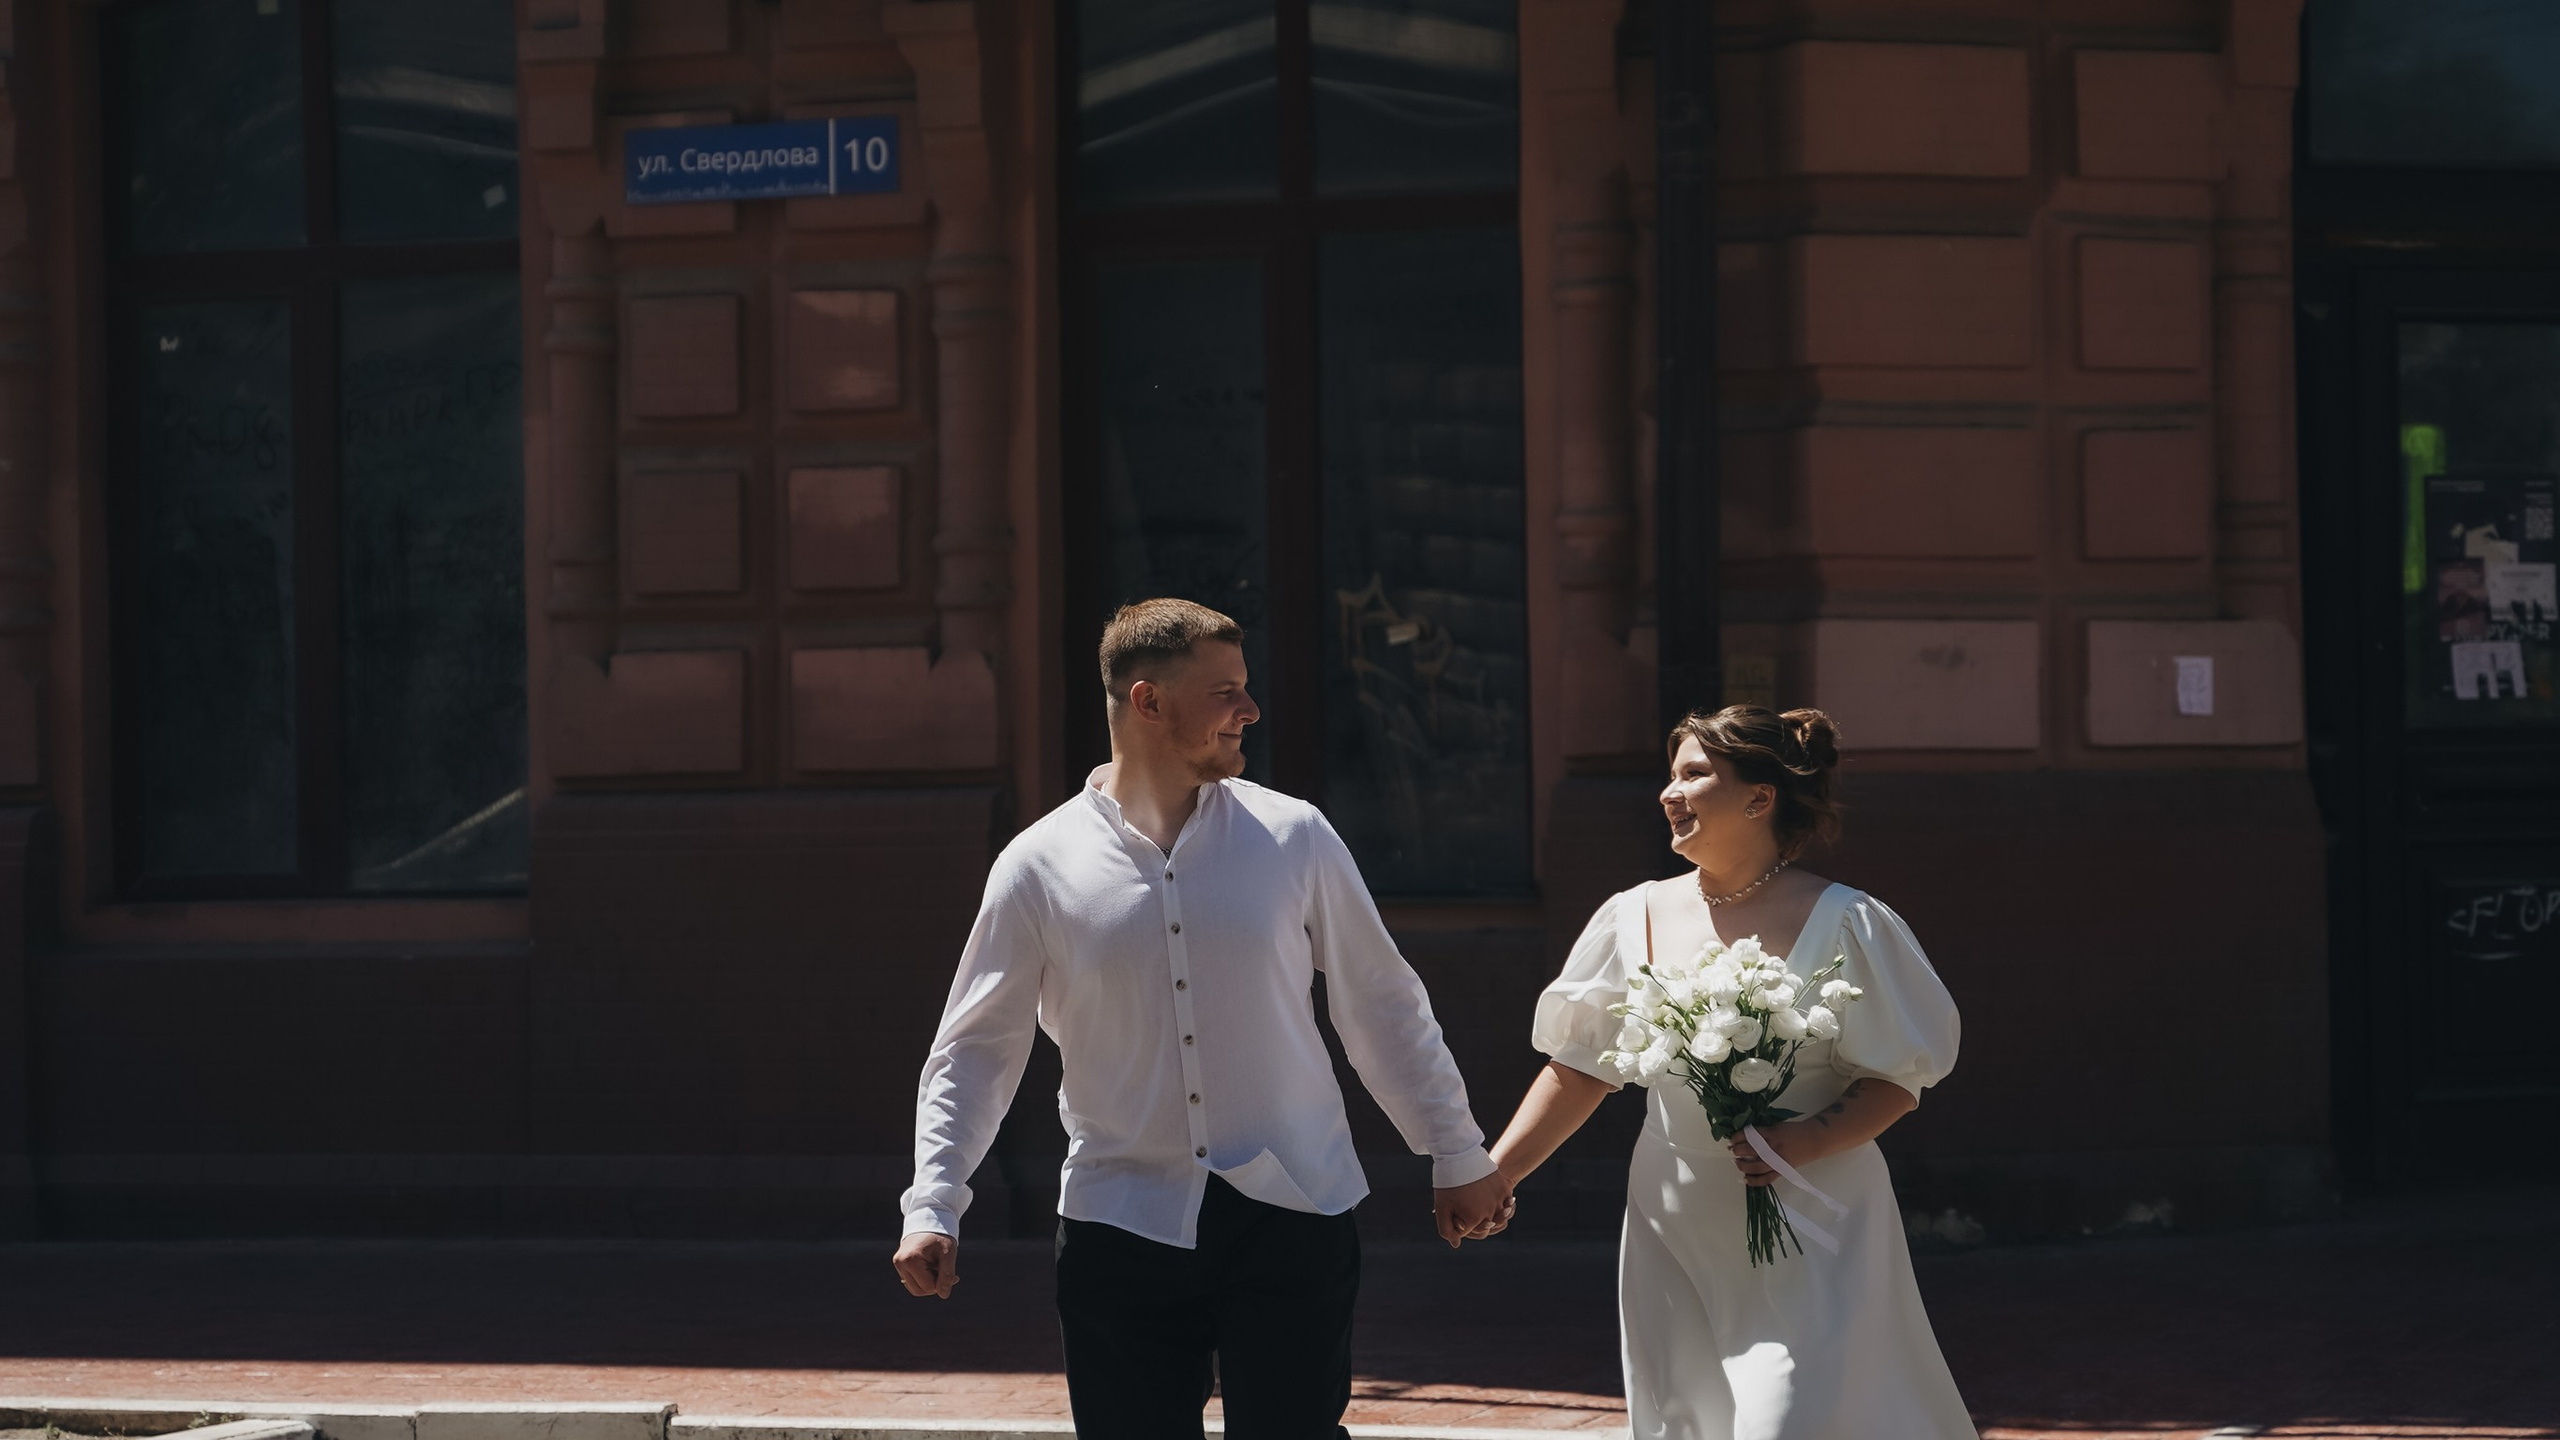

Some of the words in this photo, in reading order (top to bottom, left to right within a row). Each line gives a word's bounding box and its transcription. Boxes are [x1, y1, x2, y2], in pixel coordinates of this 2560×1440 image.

[637, 153, 673, 180] ул.
[679, 146, 820, 175] Свердлова
[843, 135, 889, 173] 10
